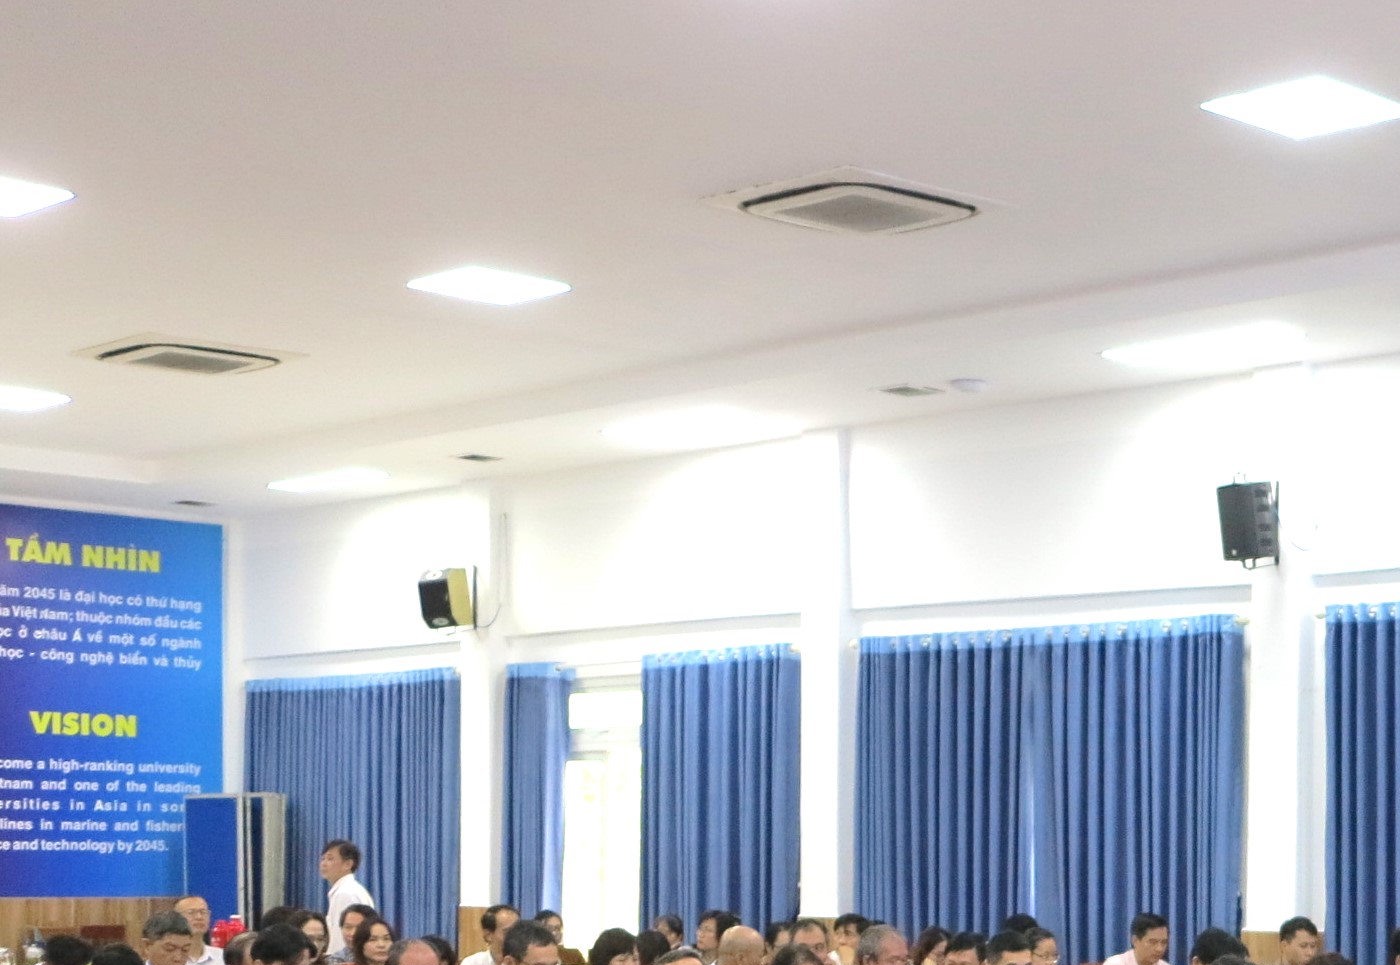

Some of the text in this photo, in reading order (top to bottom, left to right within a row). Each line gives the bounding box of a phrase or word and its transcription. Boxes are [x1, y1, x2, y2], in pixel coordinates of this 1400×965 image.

[82, 544, 160, 573] NHÌN
[23, 586, 56, 600] 2045
[59, 588, 71, 601] là
[75, 589, 96, 605] đại
[98, 592, 123, 606] học
[126, 594, 142, 606] có
[12, 606, 38, 620] Việt
[76, 610, 114, 625] thuộc
[115, 613, 152, 627] nhóm
[72, 628, 82, 642] Á
[40, 647, 75, 664] công
[80, 651, 114, 666] nghệ
[29, 711, 137, 737] VISION
[36, 760, 46, 770] a
[49, 758, 134, 774] high-ranking
[138, 761, 202, 776] university
[41, 779, 67, 791] and
[74, 781, 99, 791] one
[106, 780, 120, 792] of
[126, 780, 147, 792] the
[70, 799, 85, 811] in
[93, 799, 128, 812] Asia
[136, 801, 152, 812] in
[40, 818, 54, 830] in
[61, 819, 107, 831] marine
[114, 820, 138, 832] and
[12, 838, 39, 851] and
[41, 839, 115, 854] technology
[117, 839, 133, 854] by
[135, 840, 169, 852] 2045.
